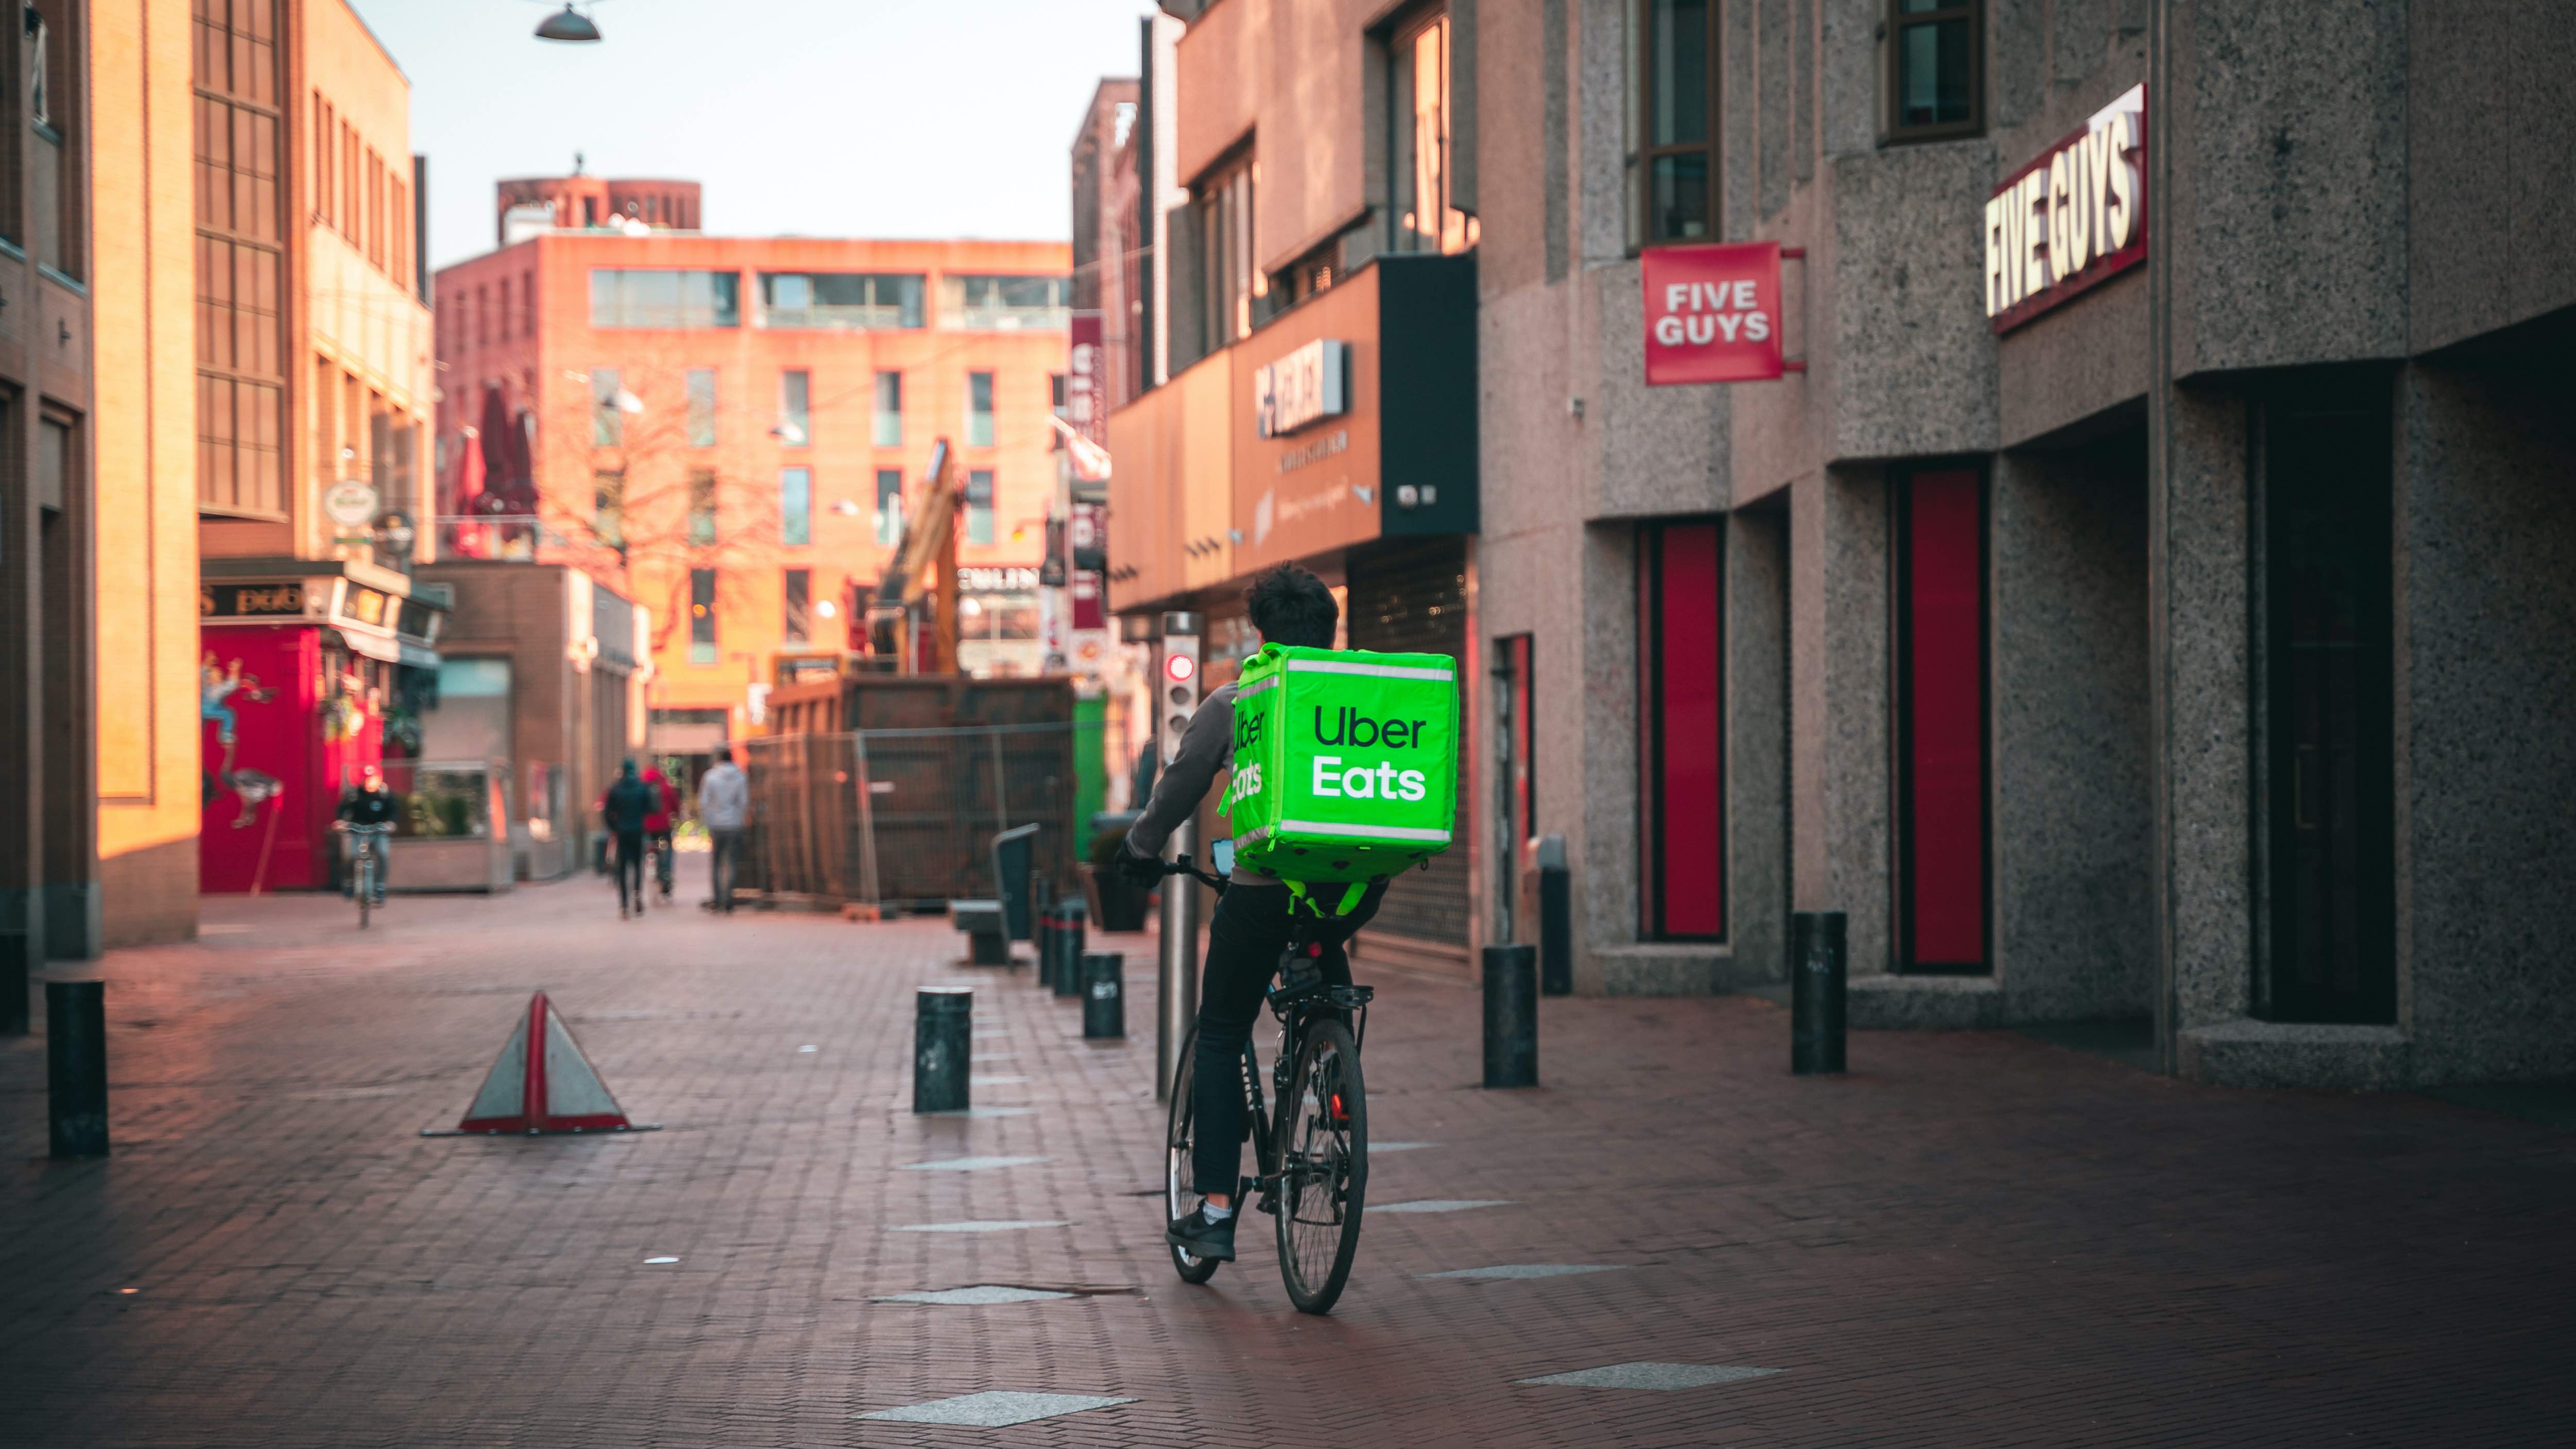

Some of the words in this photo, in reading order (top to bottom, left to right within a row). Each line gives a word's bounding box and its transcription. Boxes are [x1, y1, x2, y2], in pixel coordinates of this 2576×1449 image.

[1986, 168, 2044, 318] FIVE
[2048, 111, 2131, 282] GUYS
[1666, 280, 1757, 312] FIVE
[1655, 311, 1769, 346] GUYS
[1315, 705, 1426, 748] Uber
[1312, 756, 1426, 801] Eats
